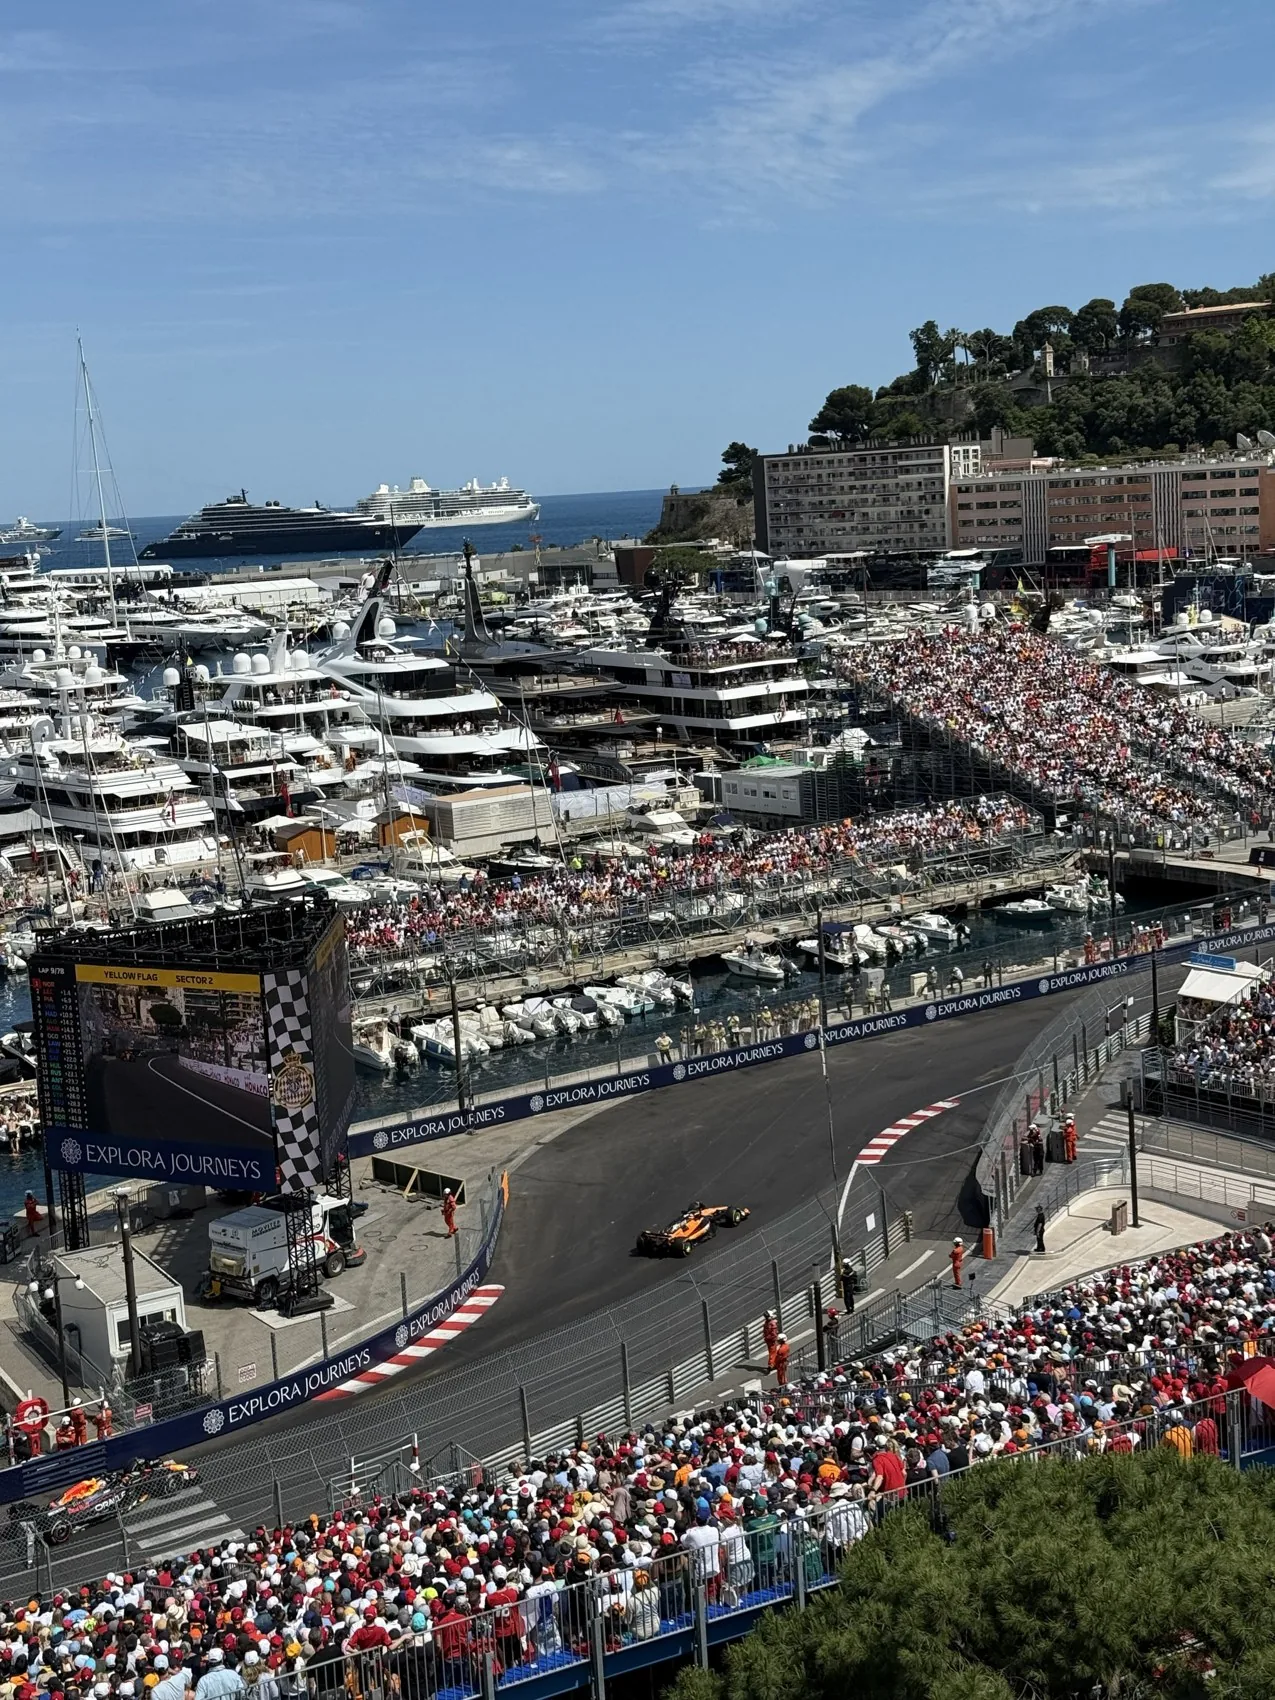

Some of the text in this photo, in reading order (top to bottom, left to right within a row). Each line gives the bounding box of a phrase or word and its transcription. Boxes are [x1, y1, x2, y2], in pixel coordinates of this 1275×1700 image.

[1209, 935, 1242, 950] EXPLORA
[104, 970, 214, 985] YELLOW FLAG SECTOR 2
[1050, 961, 1127, 989] EXPLORA JOURNEYS
[938, 987, 1021, 1015] EXPLORA JOURNEYS
[818, 1014, 907, 1043] XPLORA JOURNEYS
[687, 1043, 784, 1075] EXPLORA JOURNEYS
[546, 1073, 650, 1107] EXPLORA JOURNEYS
[391, 1121, 445, 1143] EXPLORA
[86, 1144, 261, 1180] EXPLORA JOURNEYS
[410, 1267, 480, 1337] EXPLORA JOURNEYS
[229, 1348, 371, 1424] EXPLORA JOURNEYS
